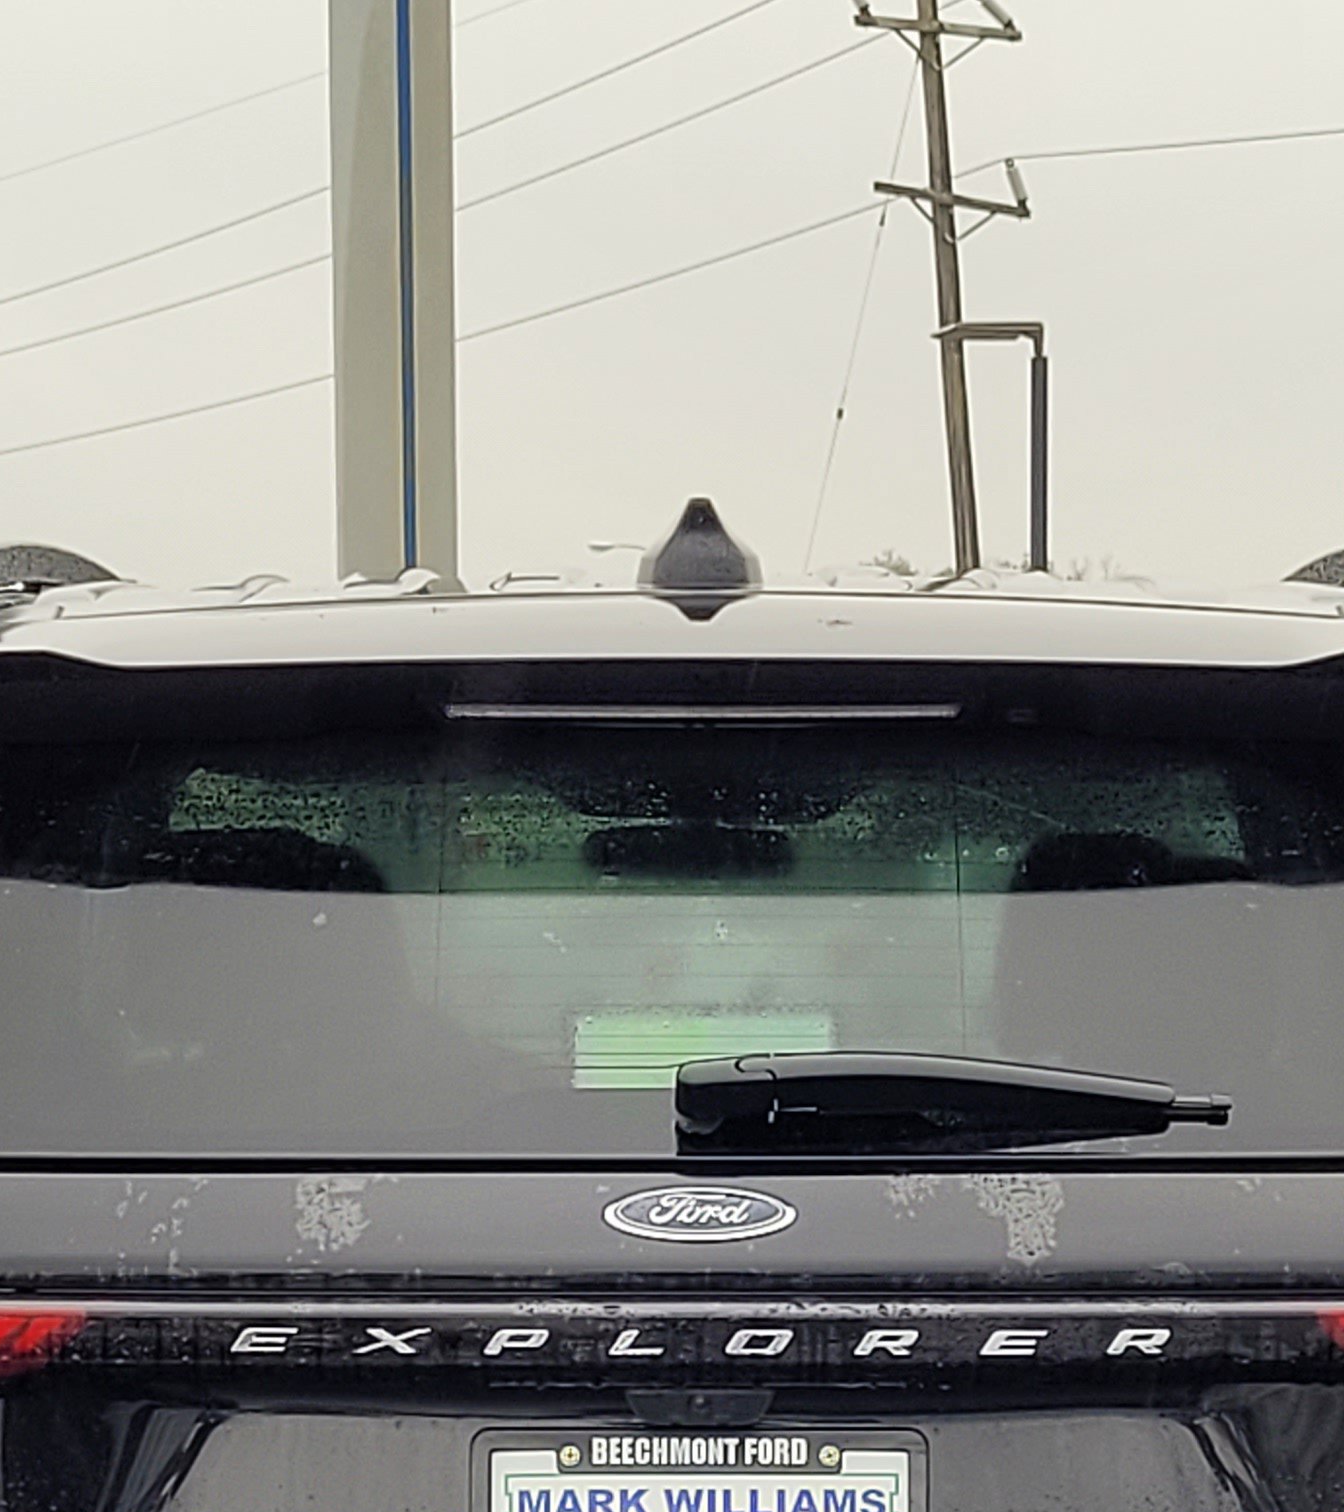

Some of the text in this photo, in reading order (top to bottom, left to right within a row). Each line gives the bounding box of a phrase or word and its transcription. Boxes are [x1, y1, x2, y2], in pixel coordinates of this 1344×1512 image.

[647, 1193, 752, 1225] Ford
[230, 1326, 1174, 1357] EXPLORER
[592, 1437, 808, 1466] BEECHMONT FORD
